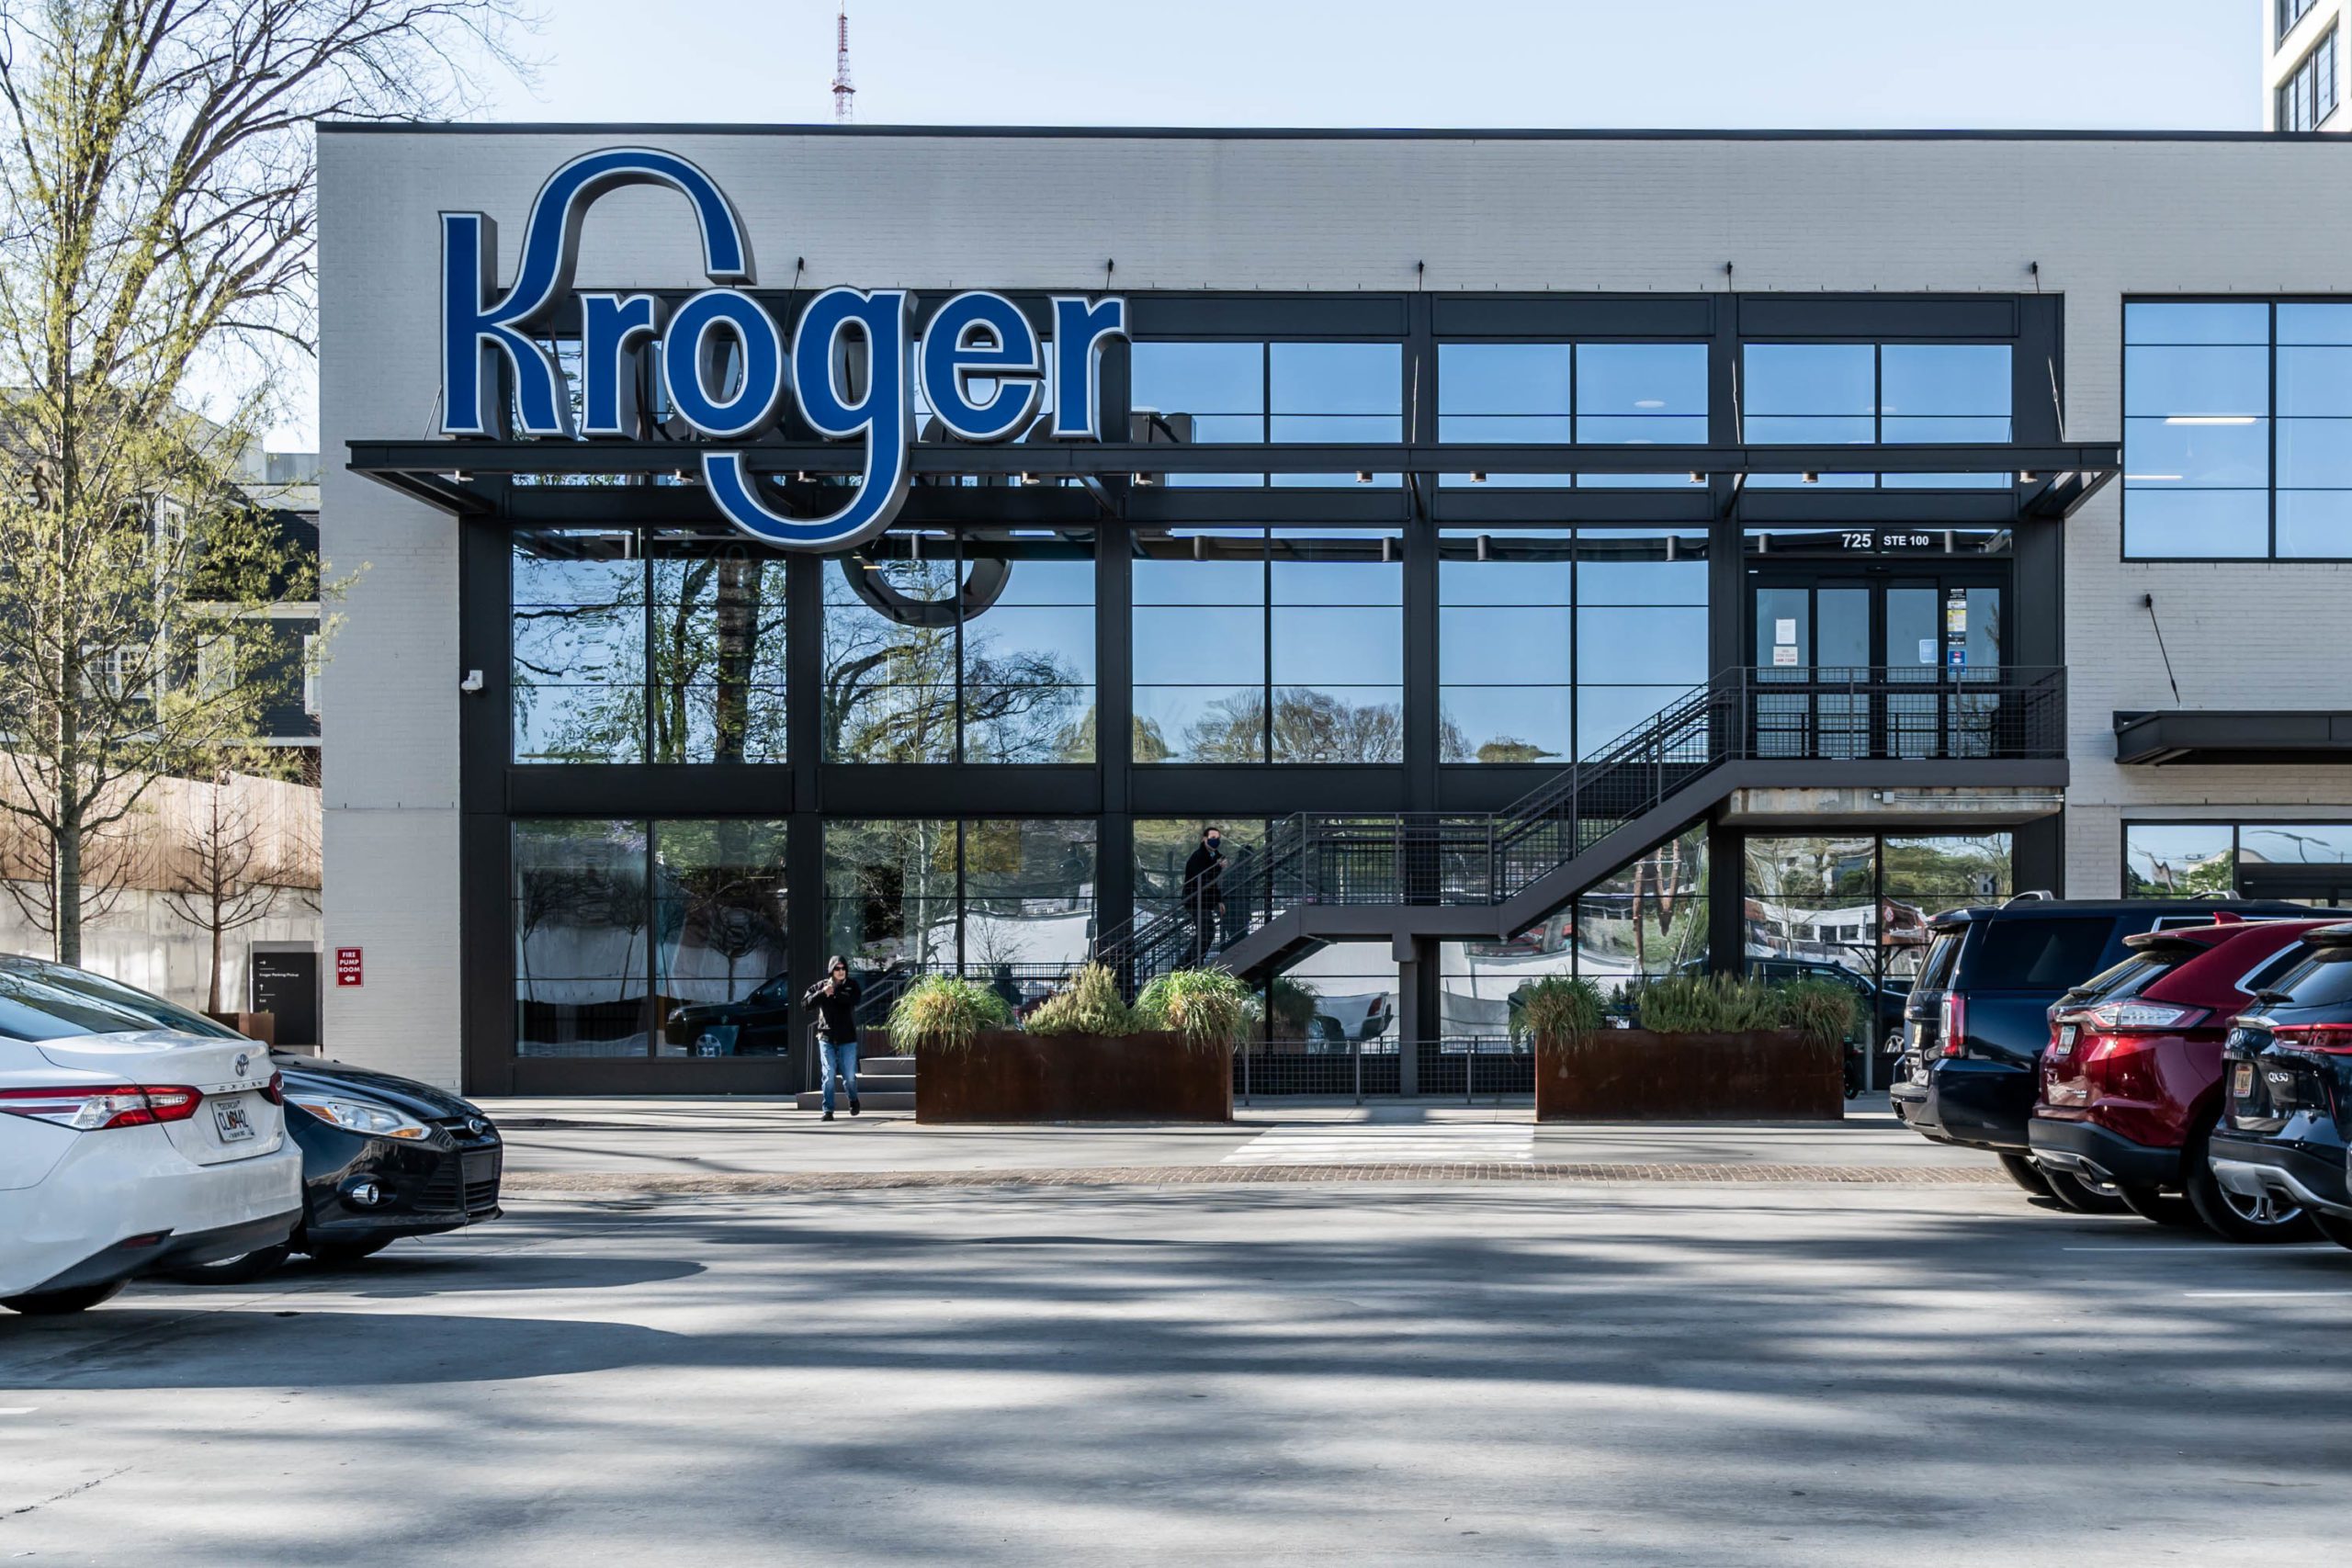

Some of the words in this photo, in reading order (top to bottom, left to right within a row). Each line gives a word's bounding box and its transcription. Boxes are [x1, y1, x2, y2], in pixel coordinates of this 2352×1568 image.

[437, 146, 1132, 551] Kroger
[1841, 533, 1871, 548] 725
[1883, 536, 1906, 546] STE
[1909, 536, 1929, 546] 100
[2267, 1072, 2289, 1083] QX50
